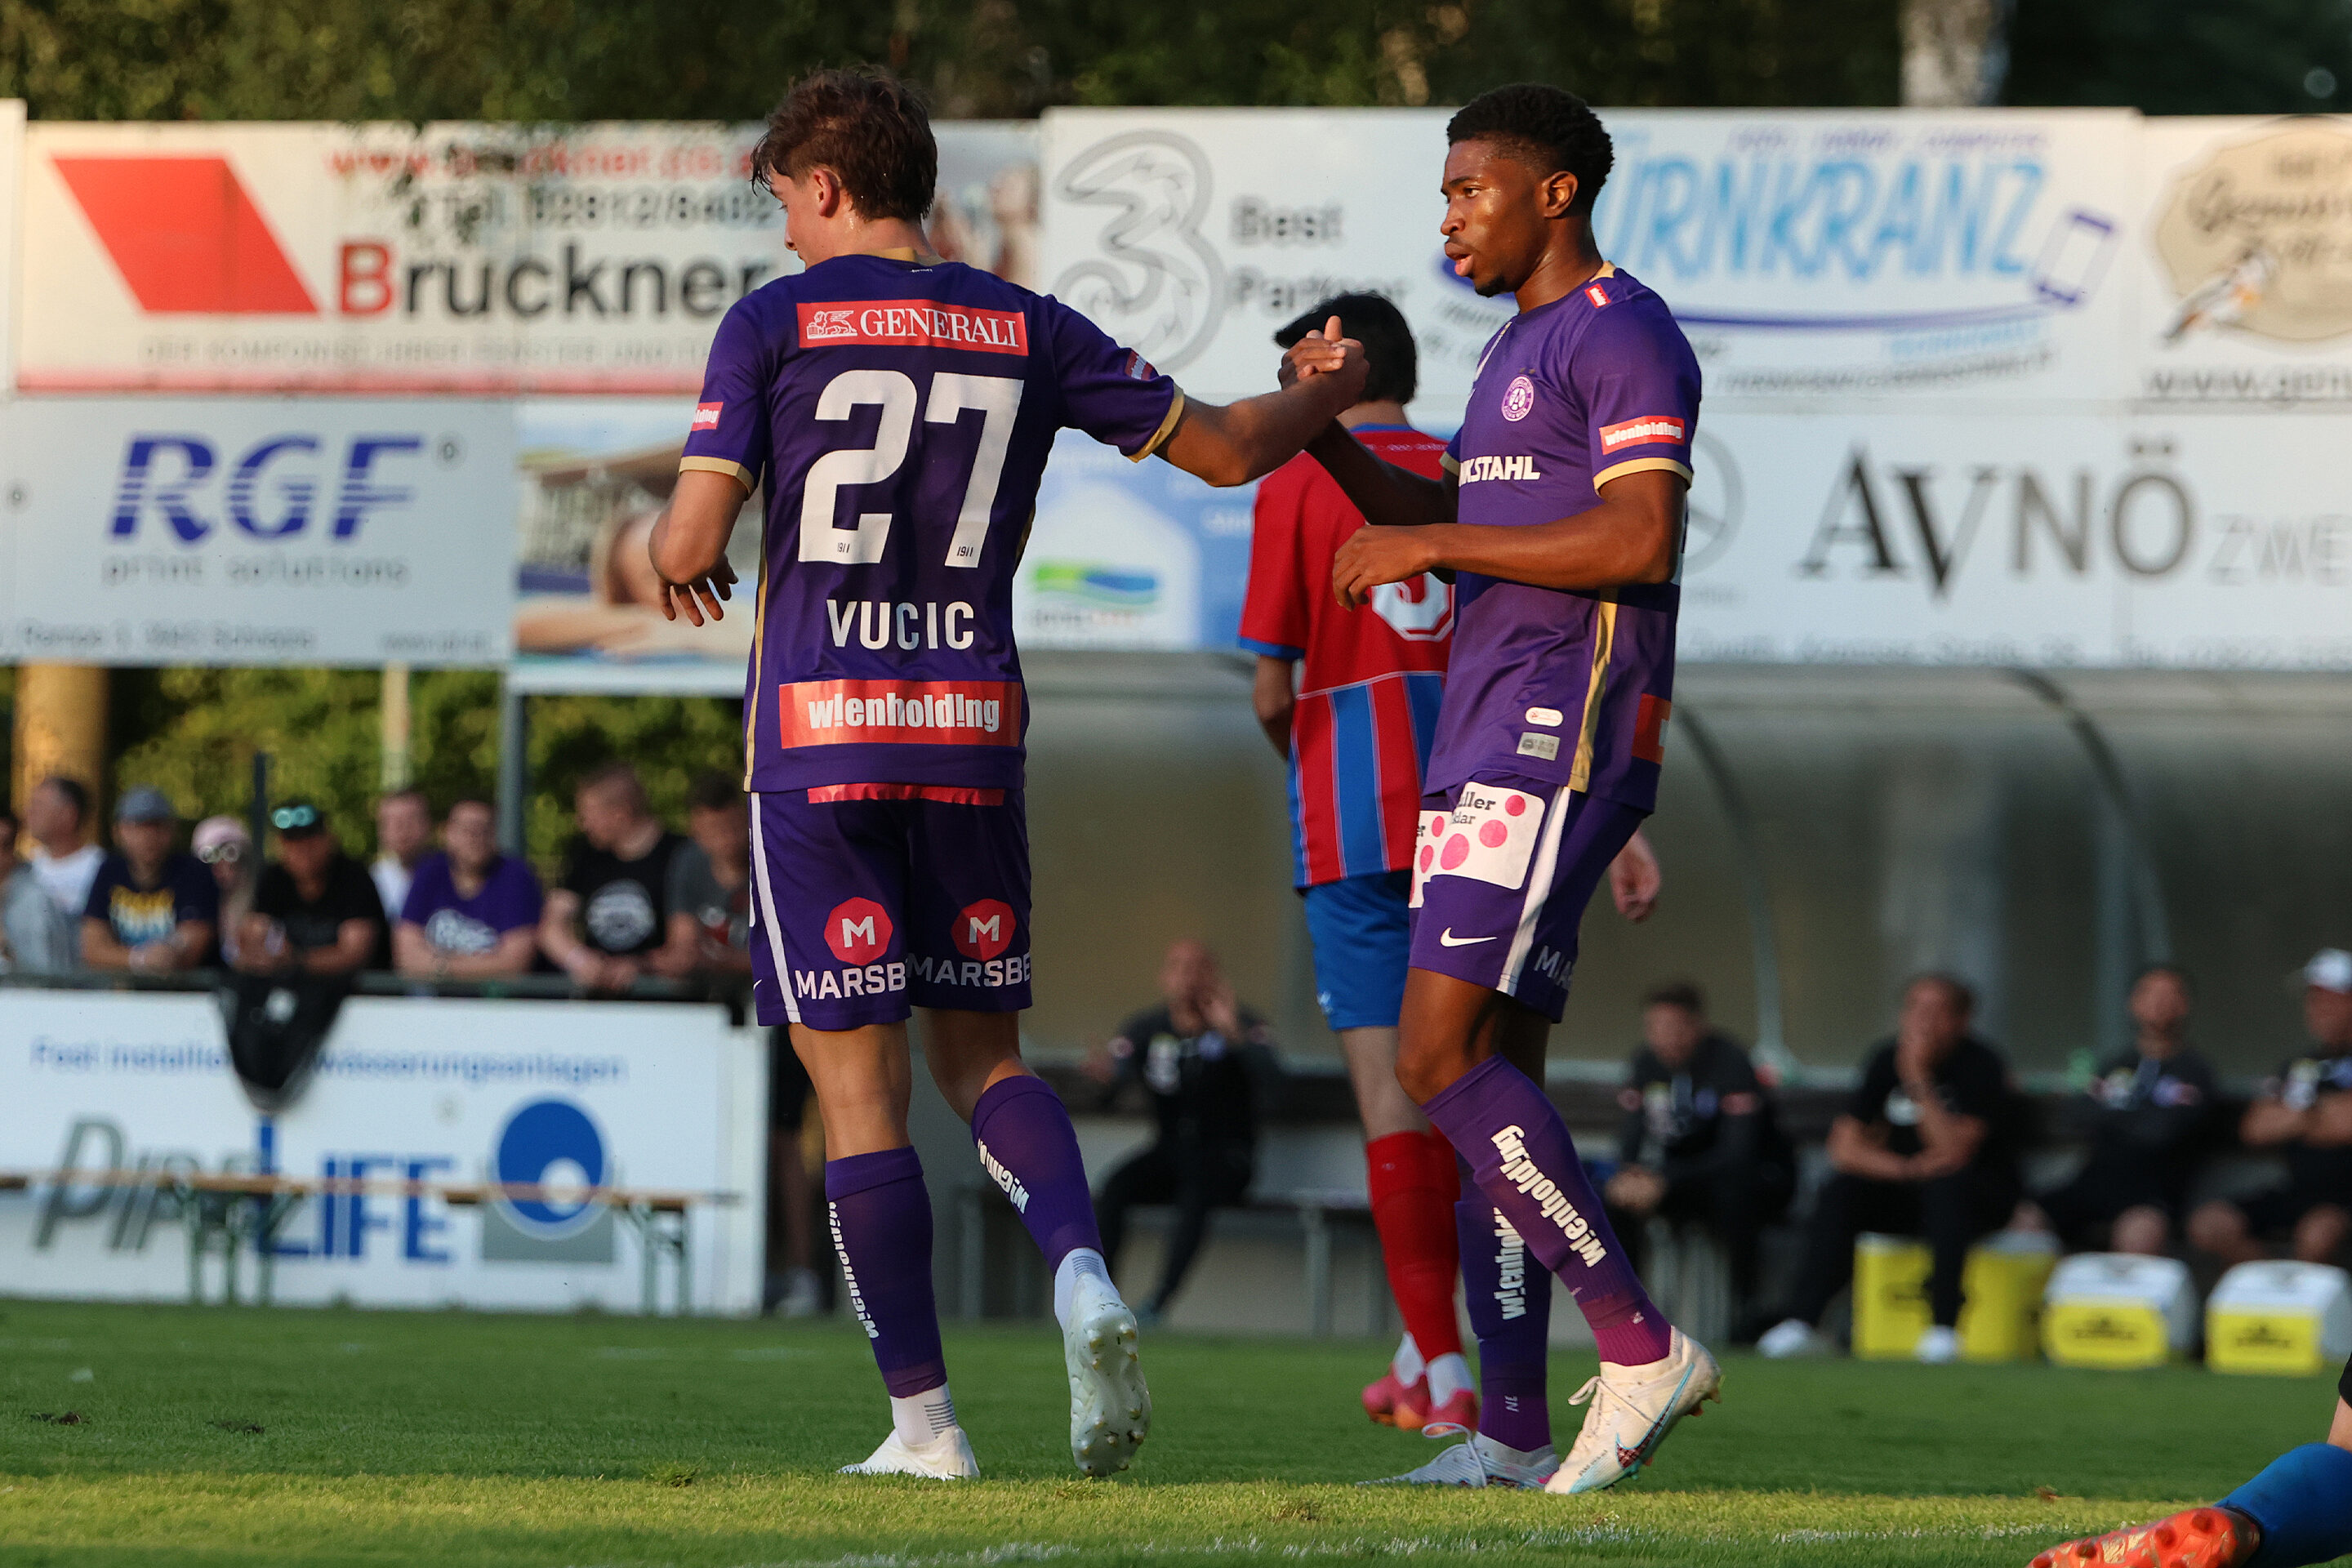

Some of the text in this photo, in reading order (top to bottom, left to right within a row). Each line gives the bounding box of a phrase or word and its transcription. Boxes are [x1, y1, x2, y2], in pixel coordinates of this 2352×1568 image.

[1232, 198, 1339, 242] Best
[337, 242, 765, 317] Bruckner
[859, 308, 1020, 348] GENERALI
[106, 432, 426, 545] RGF
[799, 369, 1025, 568] 27
[1802, 439, 2195, 603] AVNÖ
[956, 546, 974, 557] 1911
[826, 599, 975, 650] VUCIC
[1457, 791, 1496, 811] ller
[842, 915, 875, 947] M
[969, 914, 1000, 943] M
[795, 960, 907, 1000] MARSB
